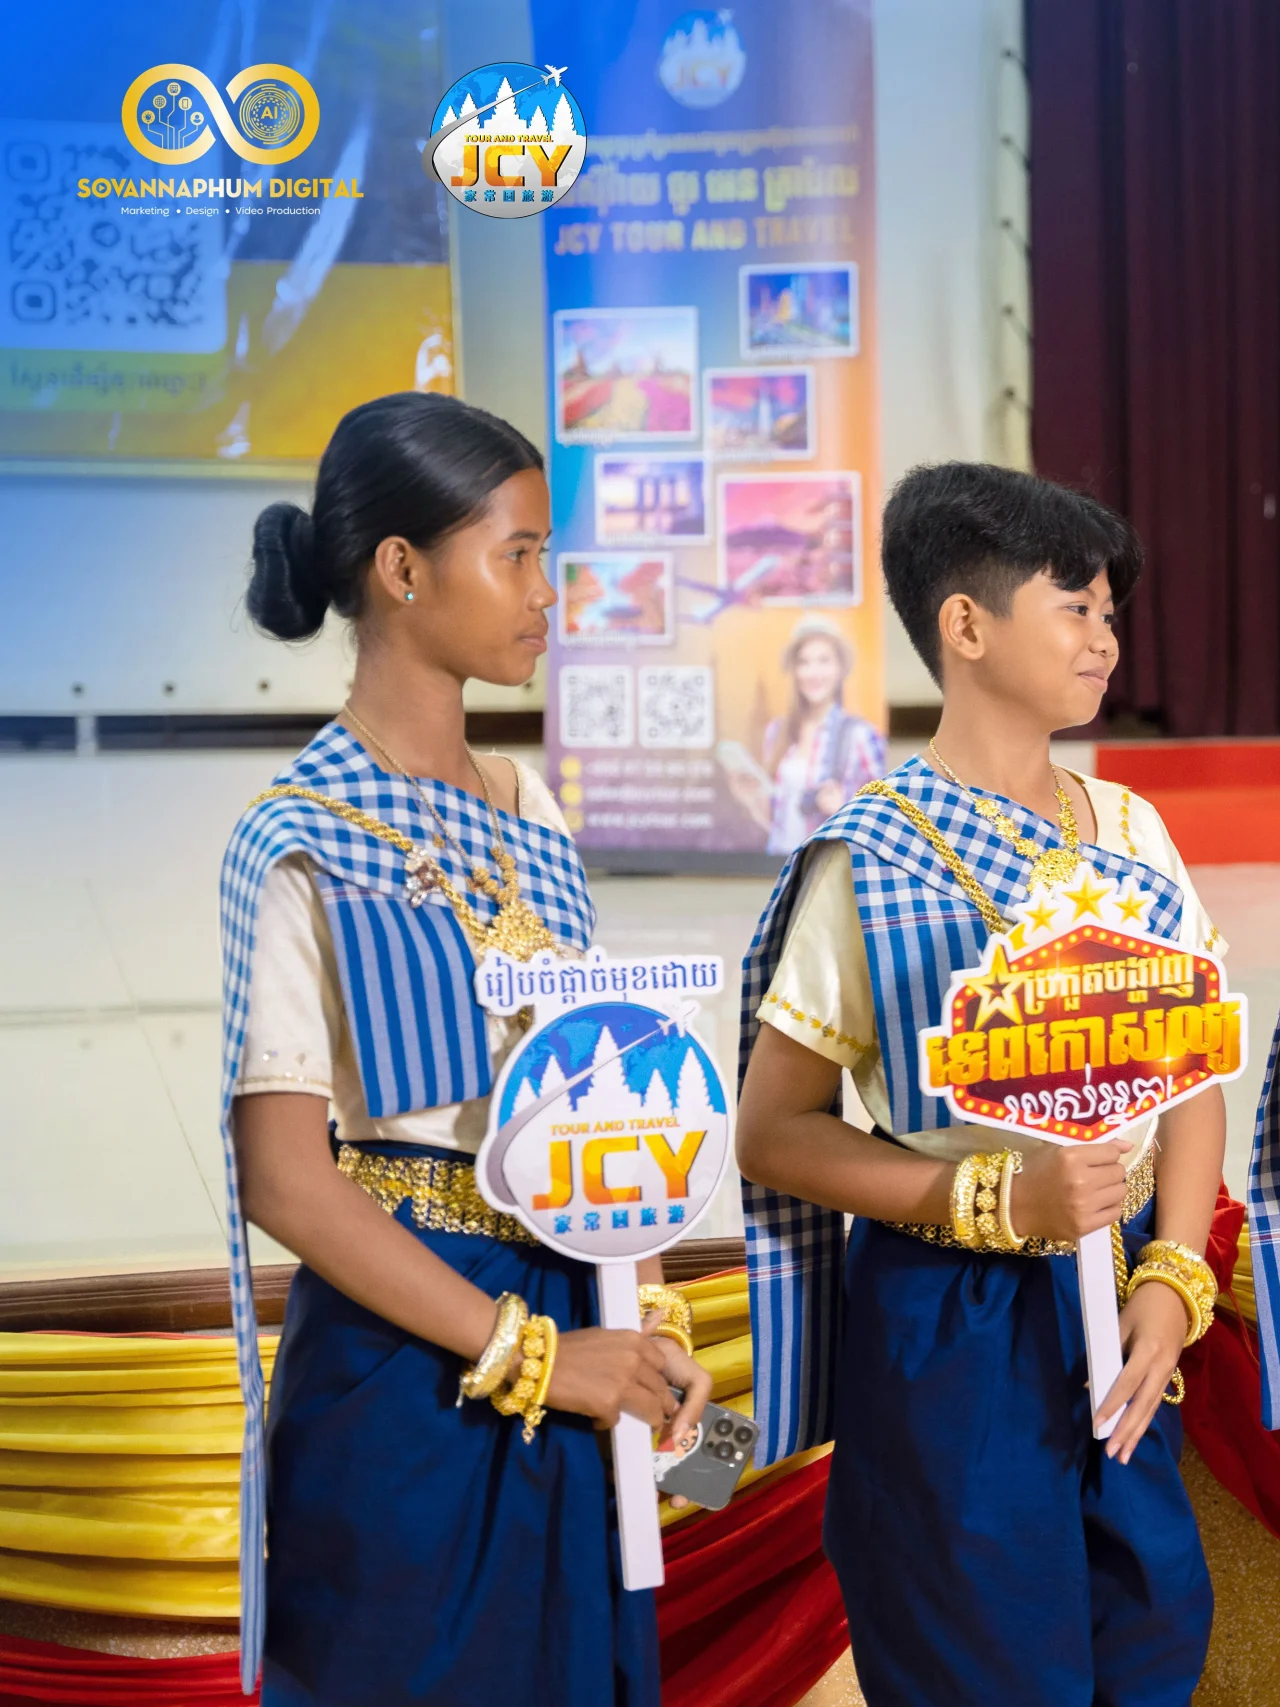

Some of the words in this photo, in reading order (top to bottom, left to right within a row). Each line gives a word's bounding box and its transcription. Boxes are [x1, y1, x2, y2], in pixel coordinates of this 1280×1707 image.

[554, 222, 603, 255] JCY
[610, 218, 684, 253] TOUR
[690, 217, 747, 251] AND
[754, 214, 856, 248] TRAVEL
[551, 1122, 589, 1136] TOUR
[593, 1119, 624, 1133] AND
[629, 1116, 680, 1131] TRAVEL
[532, 1130, 707, 1211] JCY
